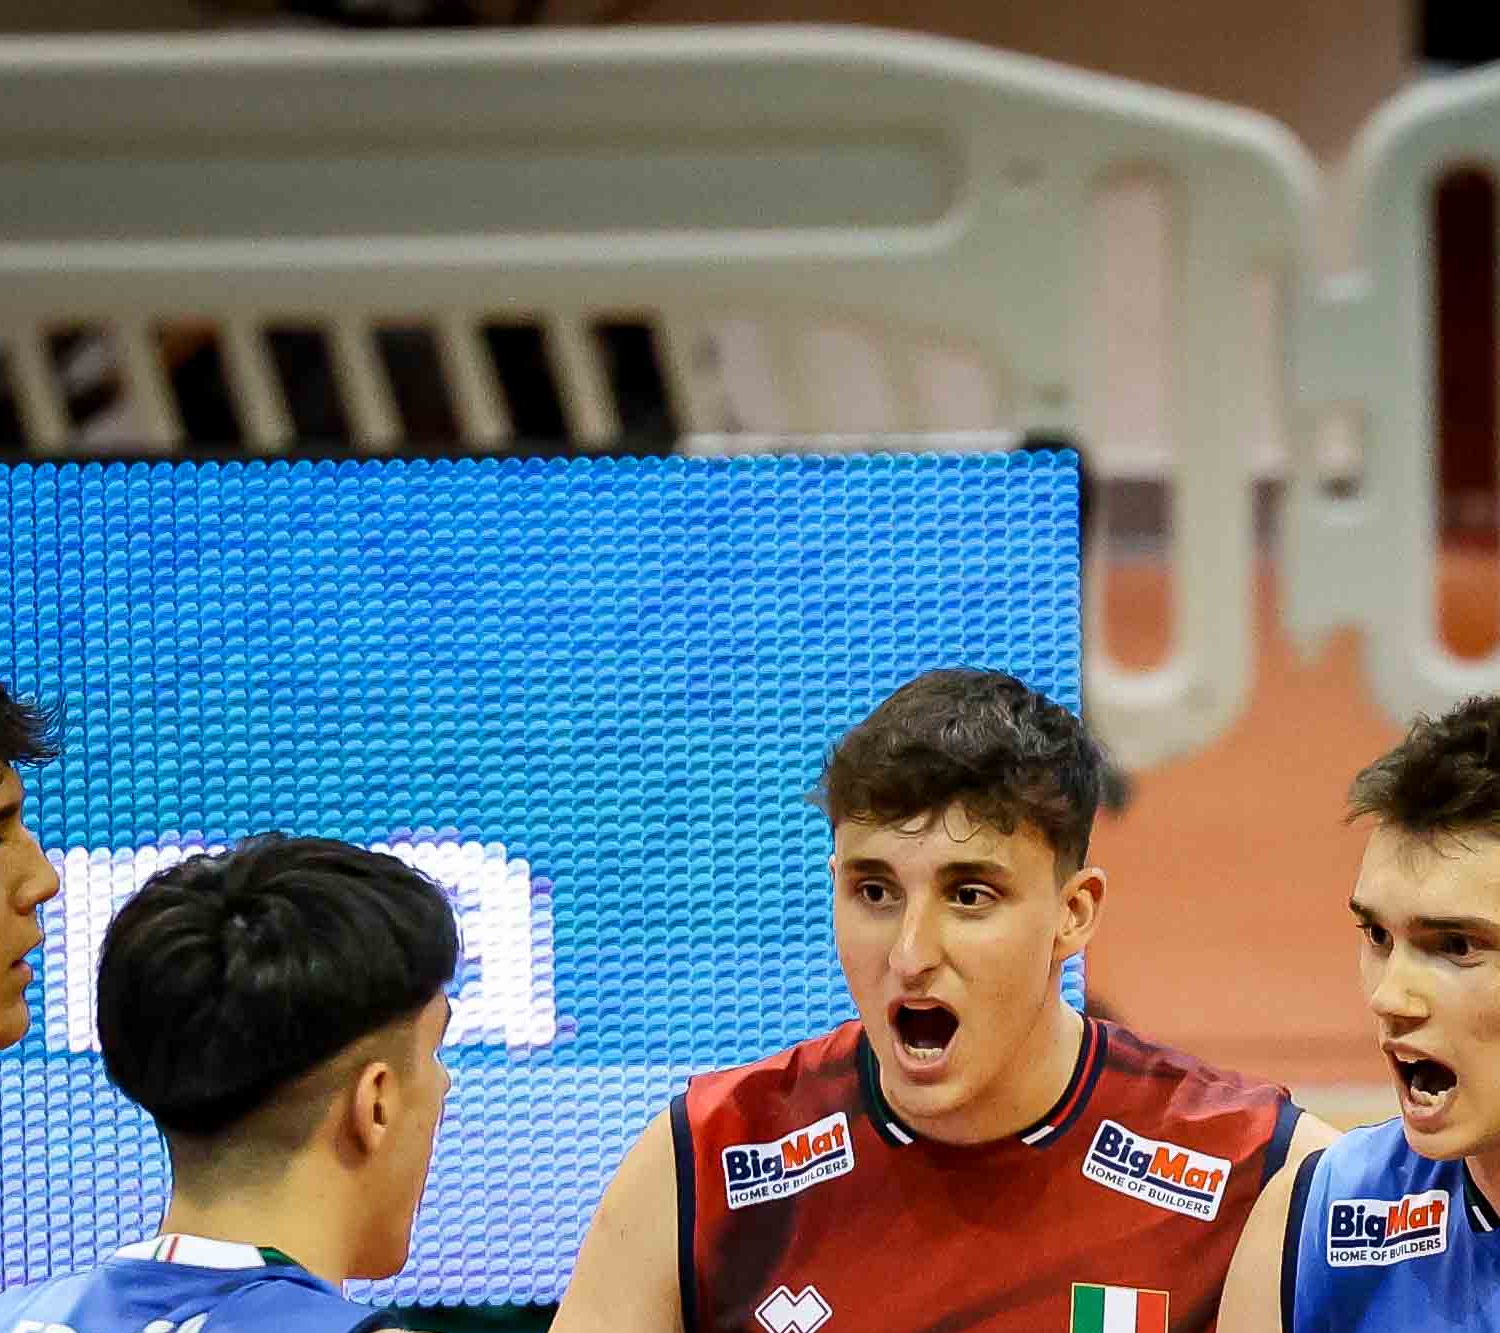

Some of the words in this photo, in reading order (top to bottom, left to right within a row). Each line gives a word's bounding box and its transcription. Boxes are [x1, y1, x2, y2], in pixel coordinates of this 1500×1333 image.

[725, 1123, 844, 1182] BigMat
[1095, 1125, 1224, 1193] BigMat
[730, 1184, 769, 1205] HOME
[772, 1182, 790, 1194] OF
[793, 1158, 849, 1189] BUILDERS
[1086, 1164, 1125, 1187] HOME
[1128, 1181, 1146, 1193] OF
[1148, 1188, 1211, 1215] BUILDERS
[1331, 1199, 1445, 1248] BigMat
[1330, 1250, 1367, 1262] HOME
[1371, 1251, 1387, 1261] OF
[1390, 1238, 1441, 1258] BUILDERS
